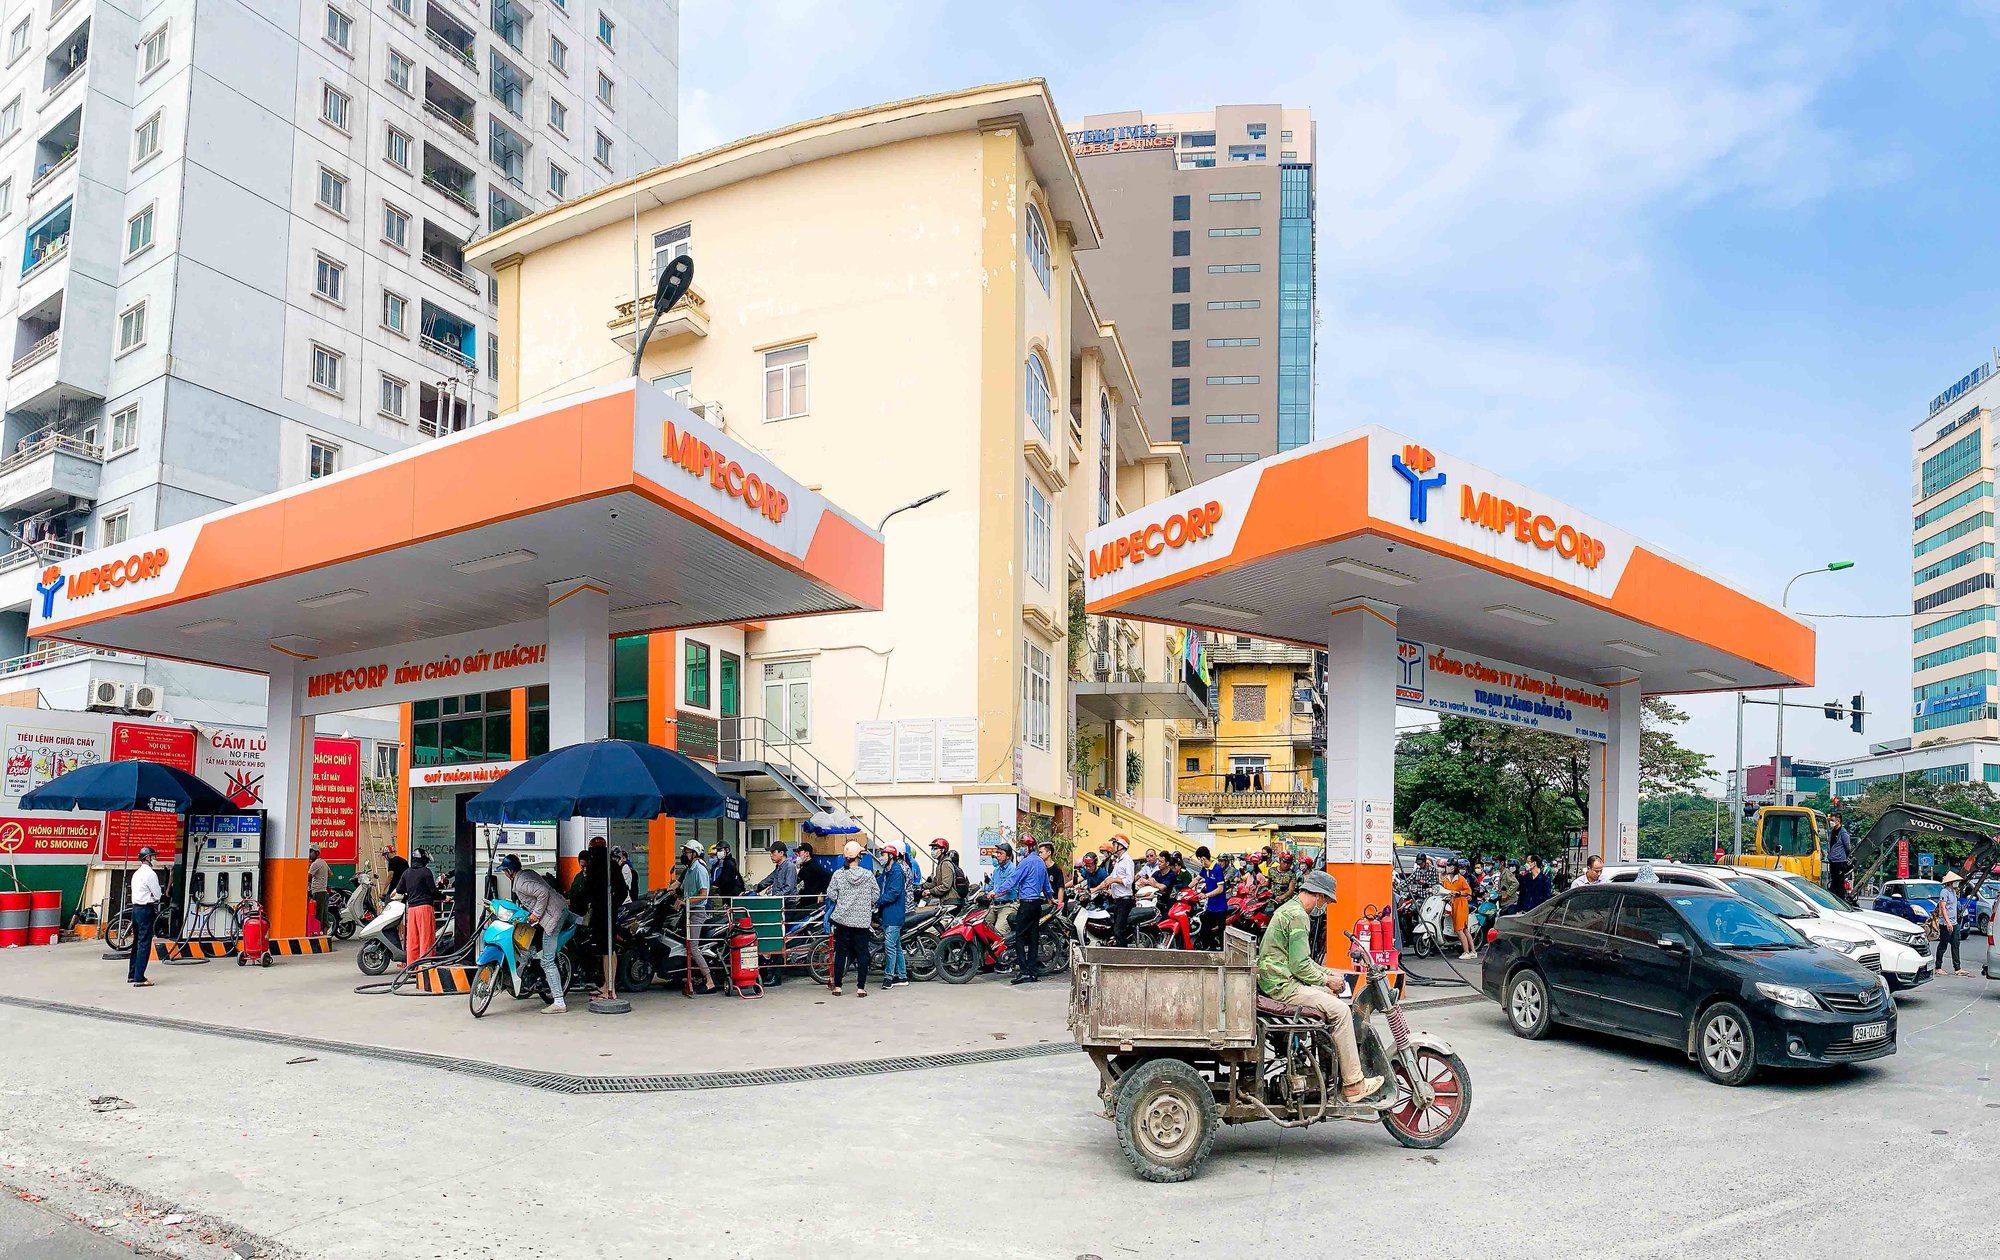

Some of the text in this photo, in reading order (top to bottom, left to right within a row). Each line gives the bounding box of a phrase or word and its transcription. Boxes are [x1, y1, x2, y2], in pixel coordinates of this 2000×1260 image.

[663, 420, 788, 523] MIPECORP
[1402, 444, 1436, 473] MP
[1089, 500, 1223, 579] MIPECORP
[1460, 484, 1605, 569] MIPECORP
[67, 548, 169, 600] MIPECORP
[308, 664, 388, 697] MIPECORP
[394, 660, 423, 685] KÍNH
[424, 654, 461, 680] CHÀO
[1428, 648, 1463, 675] TỔNG
[1464, 661, 1499, 683] CÔNG
[1500, 670, 1513, 687] TY
[1475, 689, 1502, 708] TRẠM
[1504, 694, 1533, 712] XĂNG
[17, 733, 33, 742] TIÊU
[35, 734, 54, 744] LỆNH
[212, 732, 245, 749] CẤM
[443, 768, 472, 782] KHÁCH
[28, 824, 97, 836] KHÔNG HÚT THUỐC LÁ
[1910, 818, 1944, 832] VOLVO
[35, 840, 89, 849] NO SMOKING
